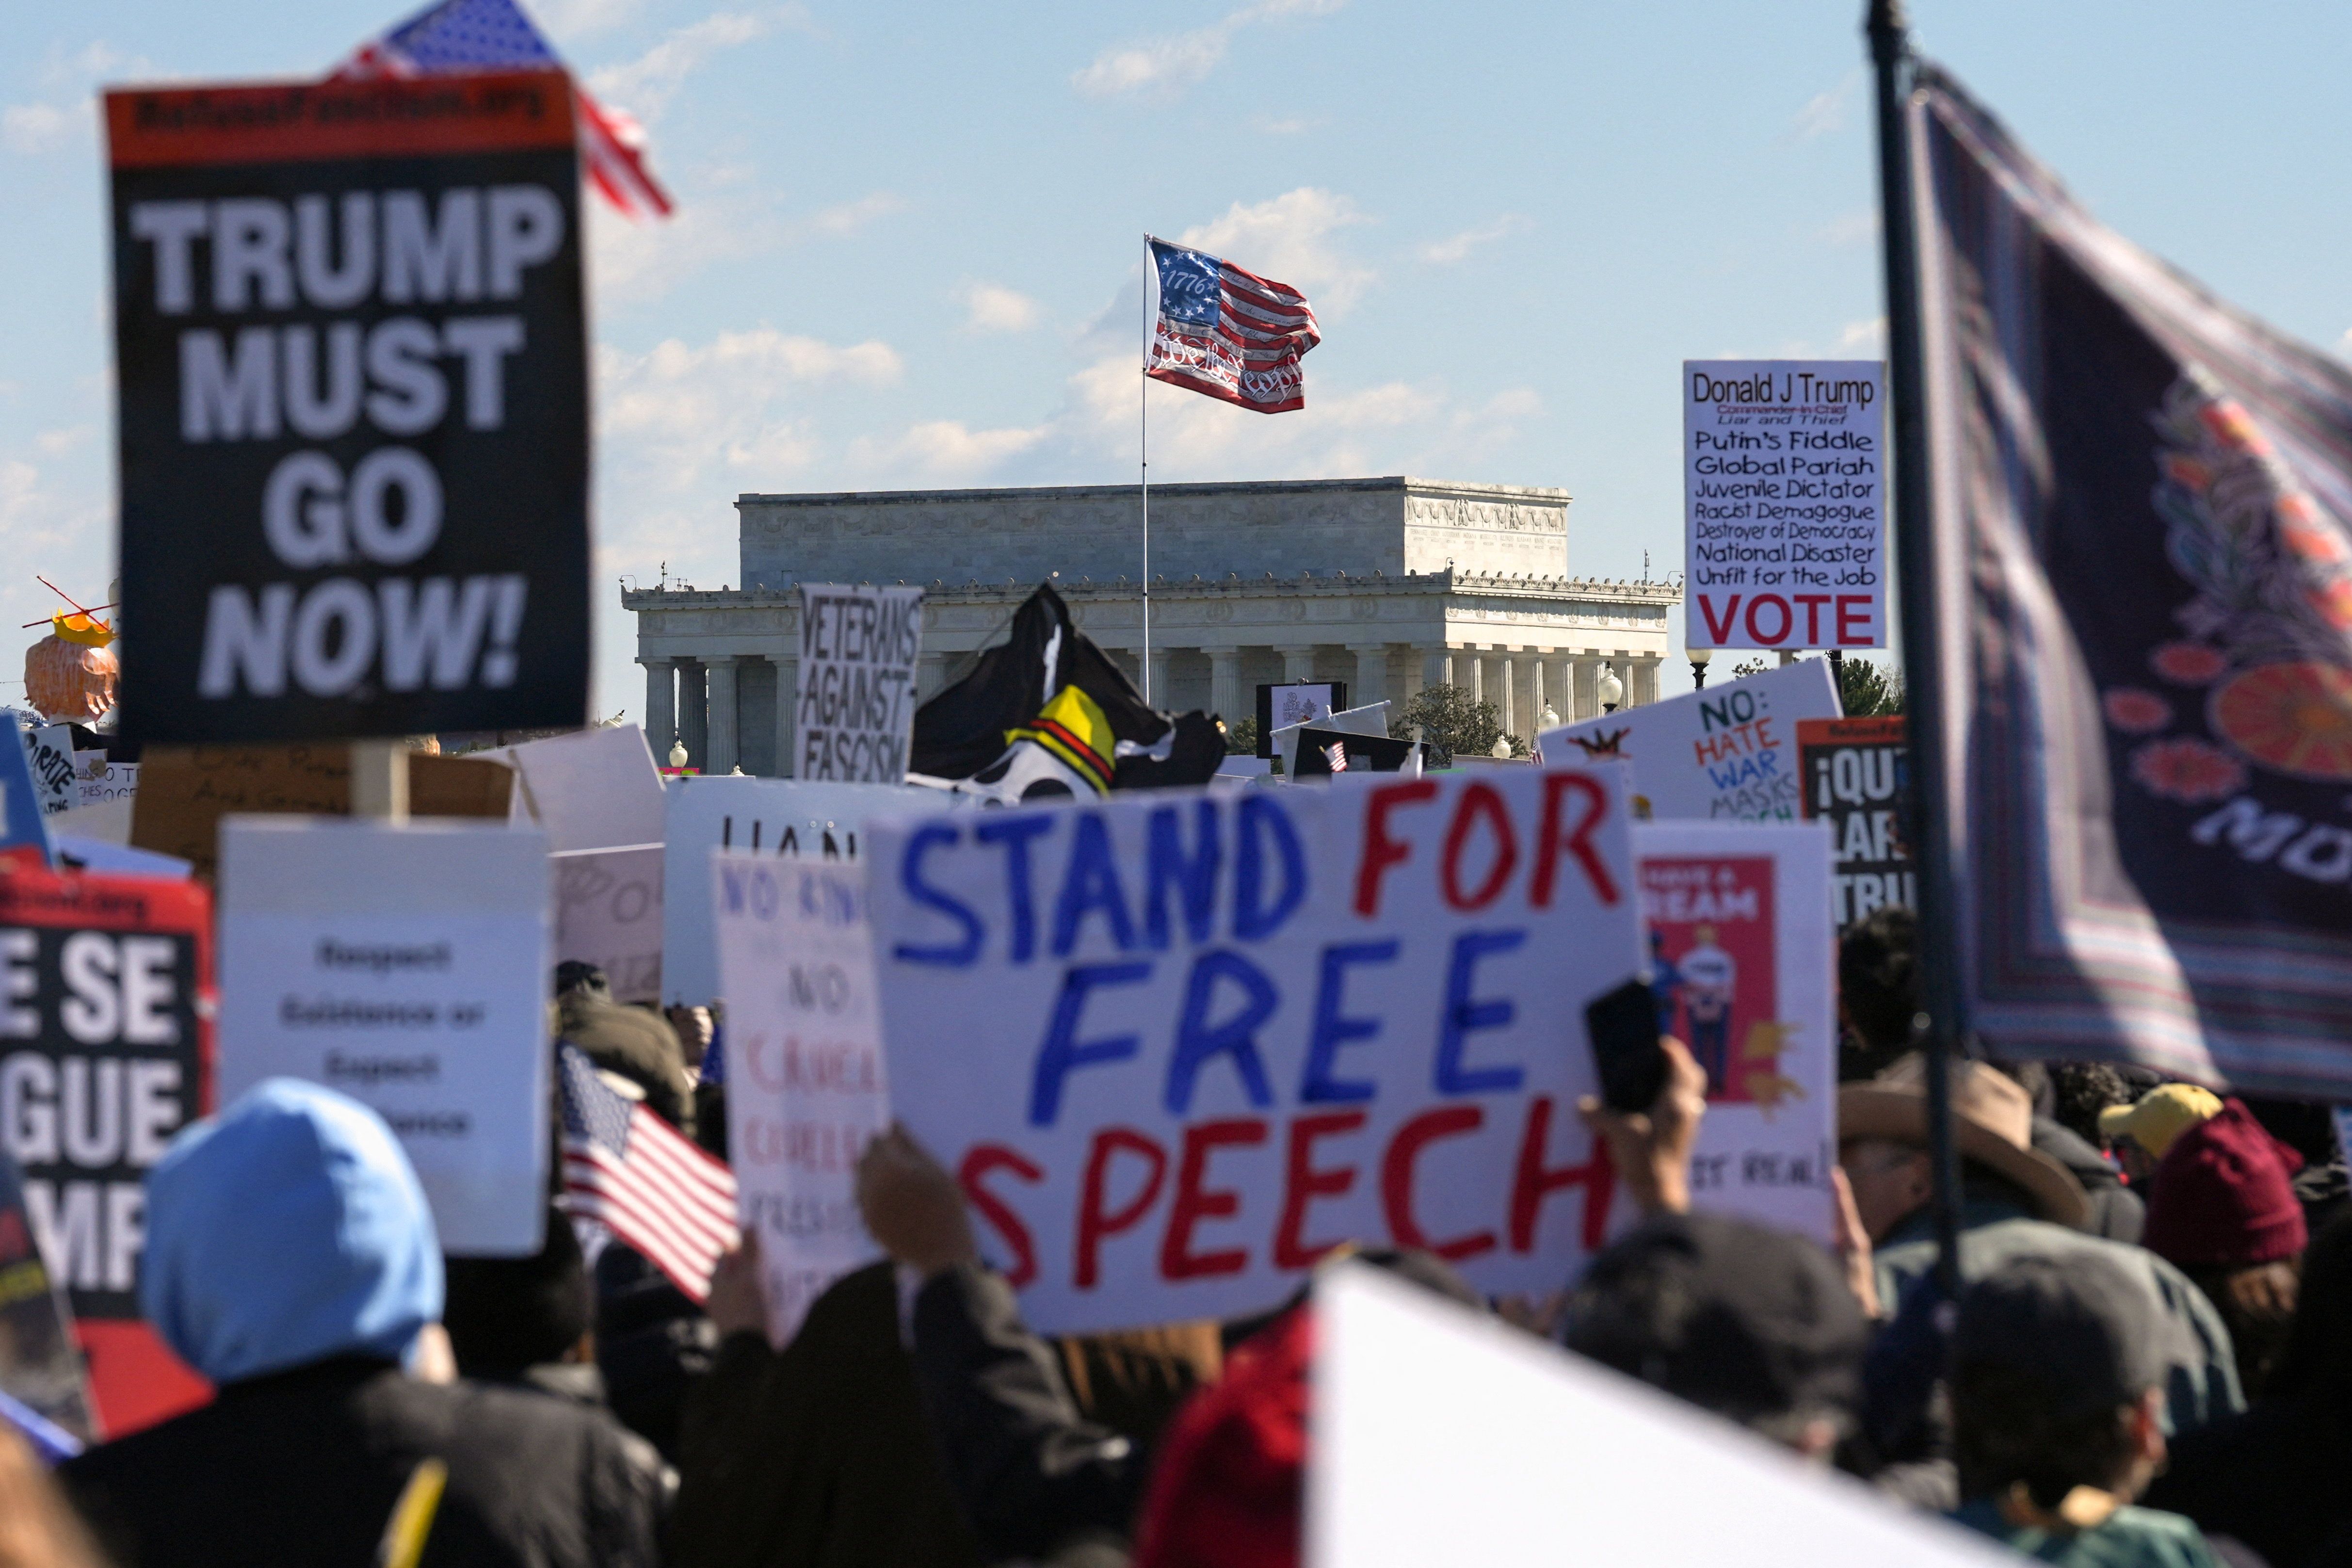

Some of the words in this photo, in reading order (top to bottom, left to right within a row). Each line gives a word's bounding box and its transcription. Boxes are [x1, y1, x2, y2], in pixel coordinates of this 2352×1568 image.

[130, 183, 565, 314] TRUMP
[1166, 270, 1208, 294] 1776
[177, 316, 525, 441] MUST
[1693, 373, 1772, 403] Donald
[1780, 373, 1792, 403] J
[1799, 373, 1874, 411] Trump
[1695, 431, 1782, 451] Putin's
[1789, 431, 1874, 452] Fiddle
[1717, 415, 1751, 425] Liar
[1758, 415, 1793, 425] and
[1799, 414, 1848, 425] Thief
[1695, 455, 1785, 475] Global
[1792, 456, 1874, 476] Pariah
[1695, 479, 1781, 499] Juvenile
[1786, 479, 1874, 499] Dictator
[262, 446, 445, 569] GO
[1695, 502, 1752, 519] Racist
[1757, 502, 1875, 522] Demagogue
[1696, 522, 1767, 541] Destroyer
[1770, 522, 1785, 539] of
[1788, 522, 1875, 542] Democracy
[1696, 567, 1746, 586] Unfit
[1754, 567, 1786, 585] for
[1791, 567, 1829, 587] the
[1834, 566, 1877, 586] Job
[1697, 542, 1787, 563] National
[1791, 543, 1875, 564] Disaster
[196, 574, 531, 700] NOW!
[799, 589, 922, 665] VETERANS
[1697, 593, 1874, 646] VOTE
[801, 663, 911, 729] AGAINST
[1700, 690, 1768, 731] NO:
[24, 733, 76, 794] PIRATE
[804, 730, 905, 783] FASCISM
[1694, 717, 1781, 766] HATE
[1708, 750, 1778, 790] WAR
[1710, 771, 1799, 819] MASKS
[1816, 748, 1908, 808] ¡QU
[892, 793, 1310, 965] STAND
[1351, 771, 1622, 916] FOR
[59, 930, 178, 1046] SE
[1026, 928, 1529, 1128] FREE
[953, 1096, 1616, 1291] SPEECH
